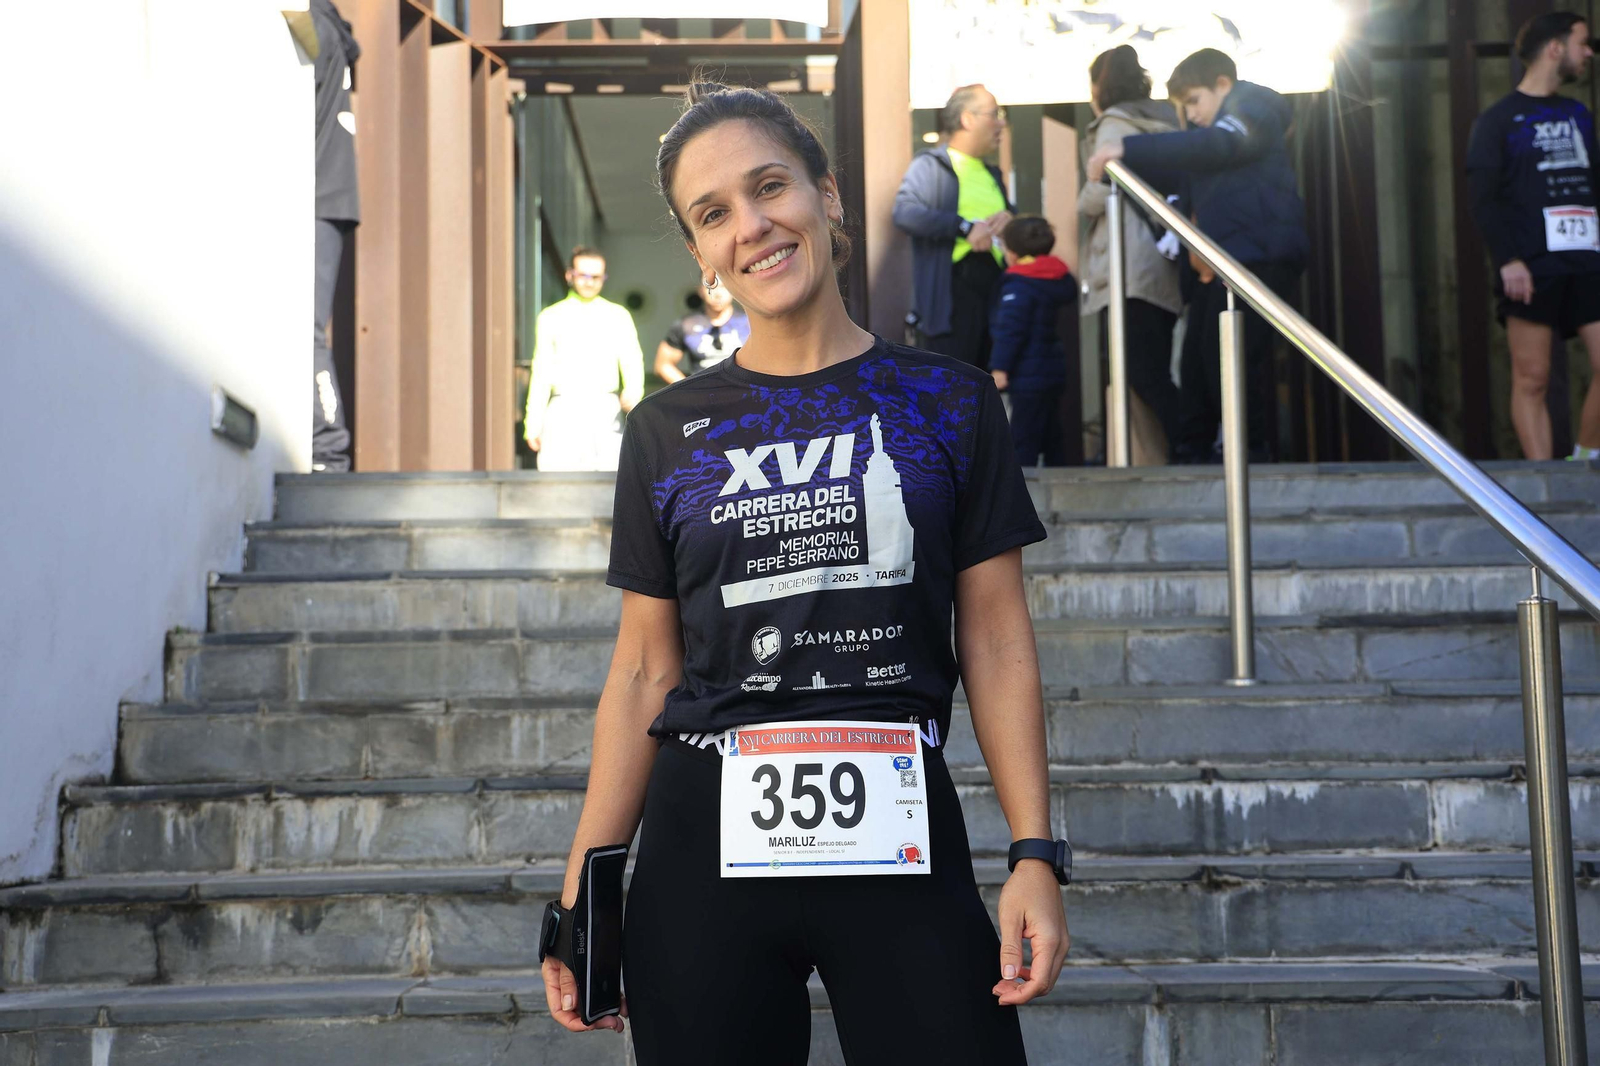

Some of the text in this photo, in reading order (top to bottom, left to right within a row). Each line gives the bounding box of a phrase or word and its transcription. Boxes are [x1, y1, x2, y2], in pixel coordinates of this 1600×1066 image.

[1533, 121, 1570, 139] XVI
[1556, 218, 1588, 237] 473
[718, 433, 855, 497] XVI
[710, 485, 855, 524] CARRERA DEL
[743, 505, 857, 538] ESTRECHO
[779, 531, 859, 553] MEMORIAL
[747, 545, 859, 574] PEPE SERRANO
[768, 569, 906, 593] 7 DICIEMBRE 2025 TARIFA
[834, 643, 870, 653] GRUPO
[867, 662, 906, 678] Better
[741, 731, 912, 747] XVI CARRERA DEL ESTRECHO
[750, 761, 866, 831] 359
[907, 809, 913, 819] S
[768, 836, 816, 847] MARILUZ
